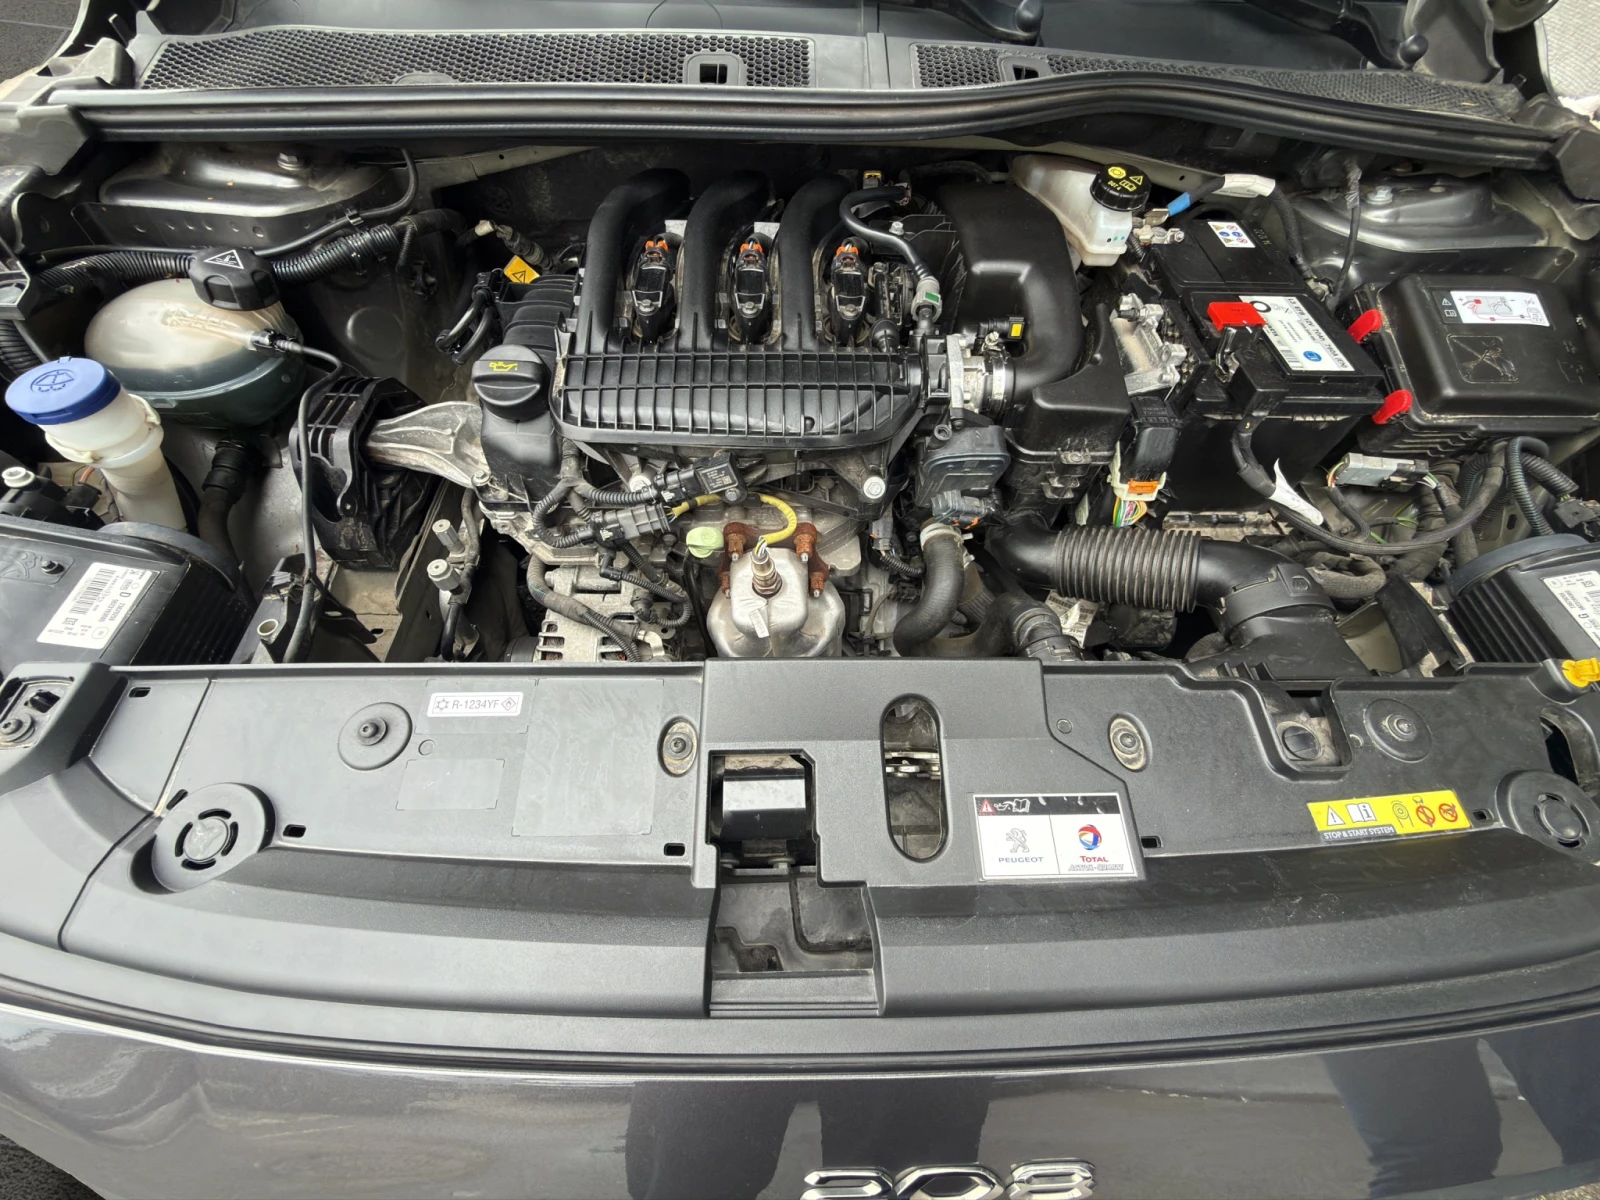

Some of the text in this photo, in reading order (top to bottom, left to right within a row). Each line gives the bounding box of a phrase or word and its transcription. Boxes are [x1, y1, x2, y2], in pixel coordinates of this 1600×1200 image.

[1304, 318, 1315, 327] 12V
[451, 699, 500, 710] R-1234YF
[1323, 831, 1341, 840] STOP
[1347, 828, 1368, 837] START
[1368, 826, 1395, 835] SYSTEM
